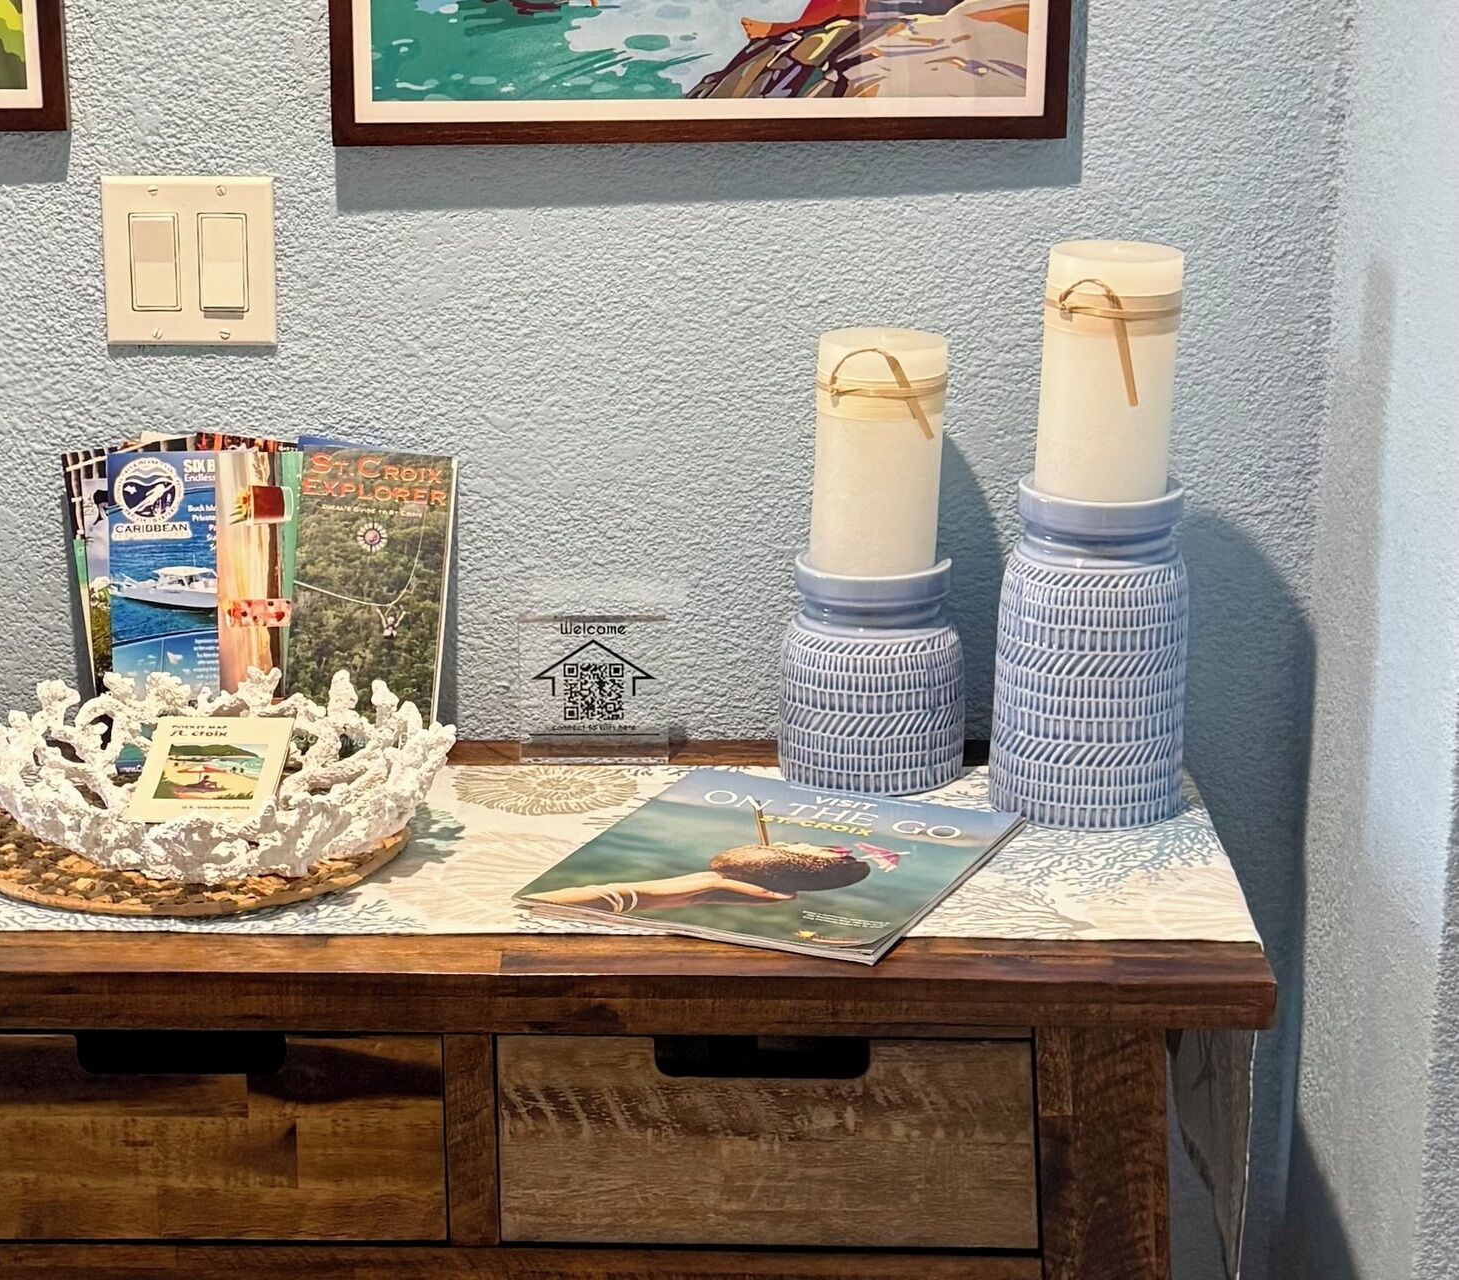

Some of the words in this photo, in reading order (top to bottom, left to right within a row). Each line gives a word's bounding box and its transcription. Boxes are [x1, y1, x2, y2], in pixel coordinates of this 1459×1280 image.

[302, 477, 448, 506] EXPLORER
[115, 523, 188, 533] CARIBBEAN
[560, 622, 627, 635] Welcome
[814, 795, 879, 811] VISIT
[703, 789, 774, 811] ON
[789, 803, 879, 827] THE
[891, 820, 962, 839] GO
[796, 820, 874, 837] CROIX
